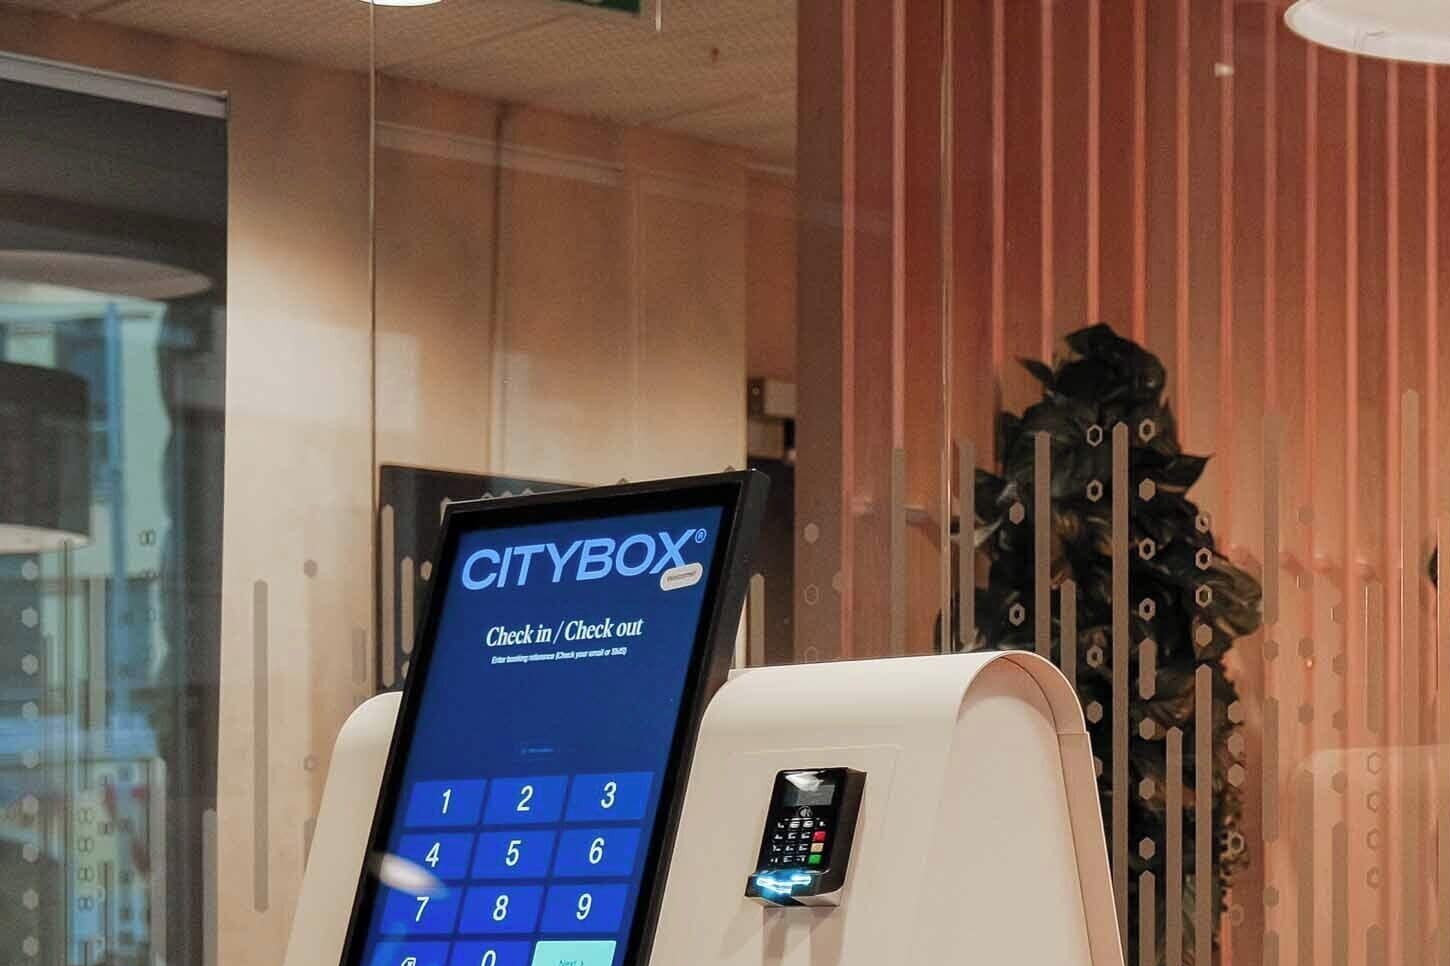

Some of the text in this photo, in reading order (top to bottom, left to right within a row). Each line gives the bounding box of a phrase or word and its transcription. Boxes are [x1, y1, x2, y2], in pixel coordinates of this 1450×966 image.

[486, 624, 533, 647] Check
[535, 624, 552, 643] in
[564, 617, 614, 641] Check
[616, 618, 645, 637] out
[441, 781, 617, 814] 1 2 3
[425, 837, 605, 867] 4 5 6
[415, 893, 592, 922] 7 8 9
